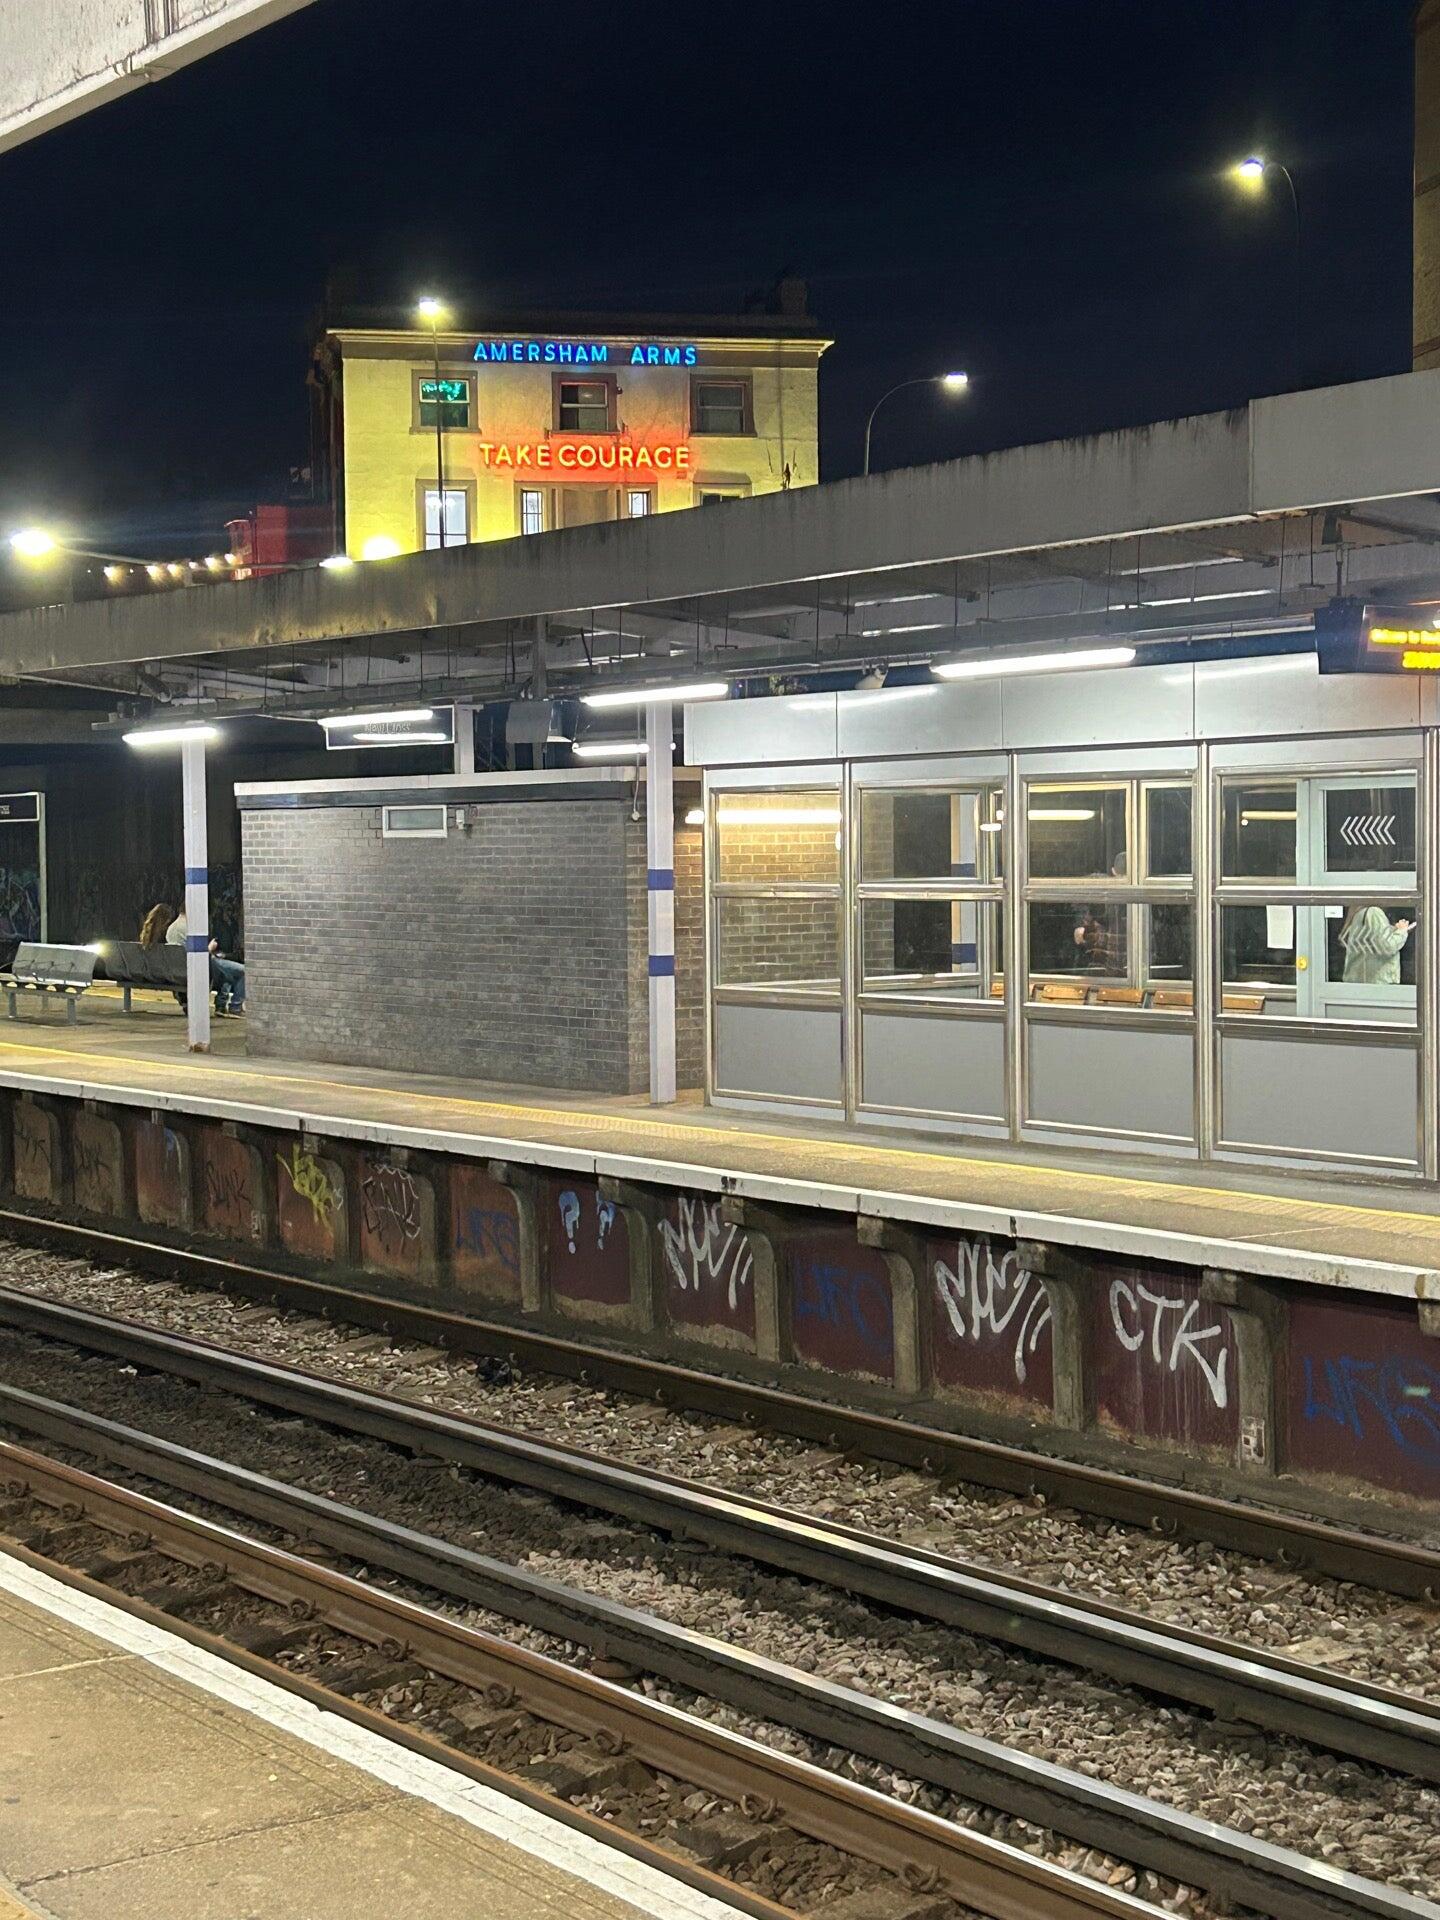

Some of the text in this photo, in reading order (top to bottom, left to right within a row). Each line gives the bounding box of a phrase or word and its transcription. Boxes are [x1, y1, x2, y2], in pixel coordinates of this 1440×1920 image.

[473, 341, 697, 366] AMERSHAM ARMS
[478, 443, 690, 469] TAKE COURAGE
